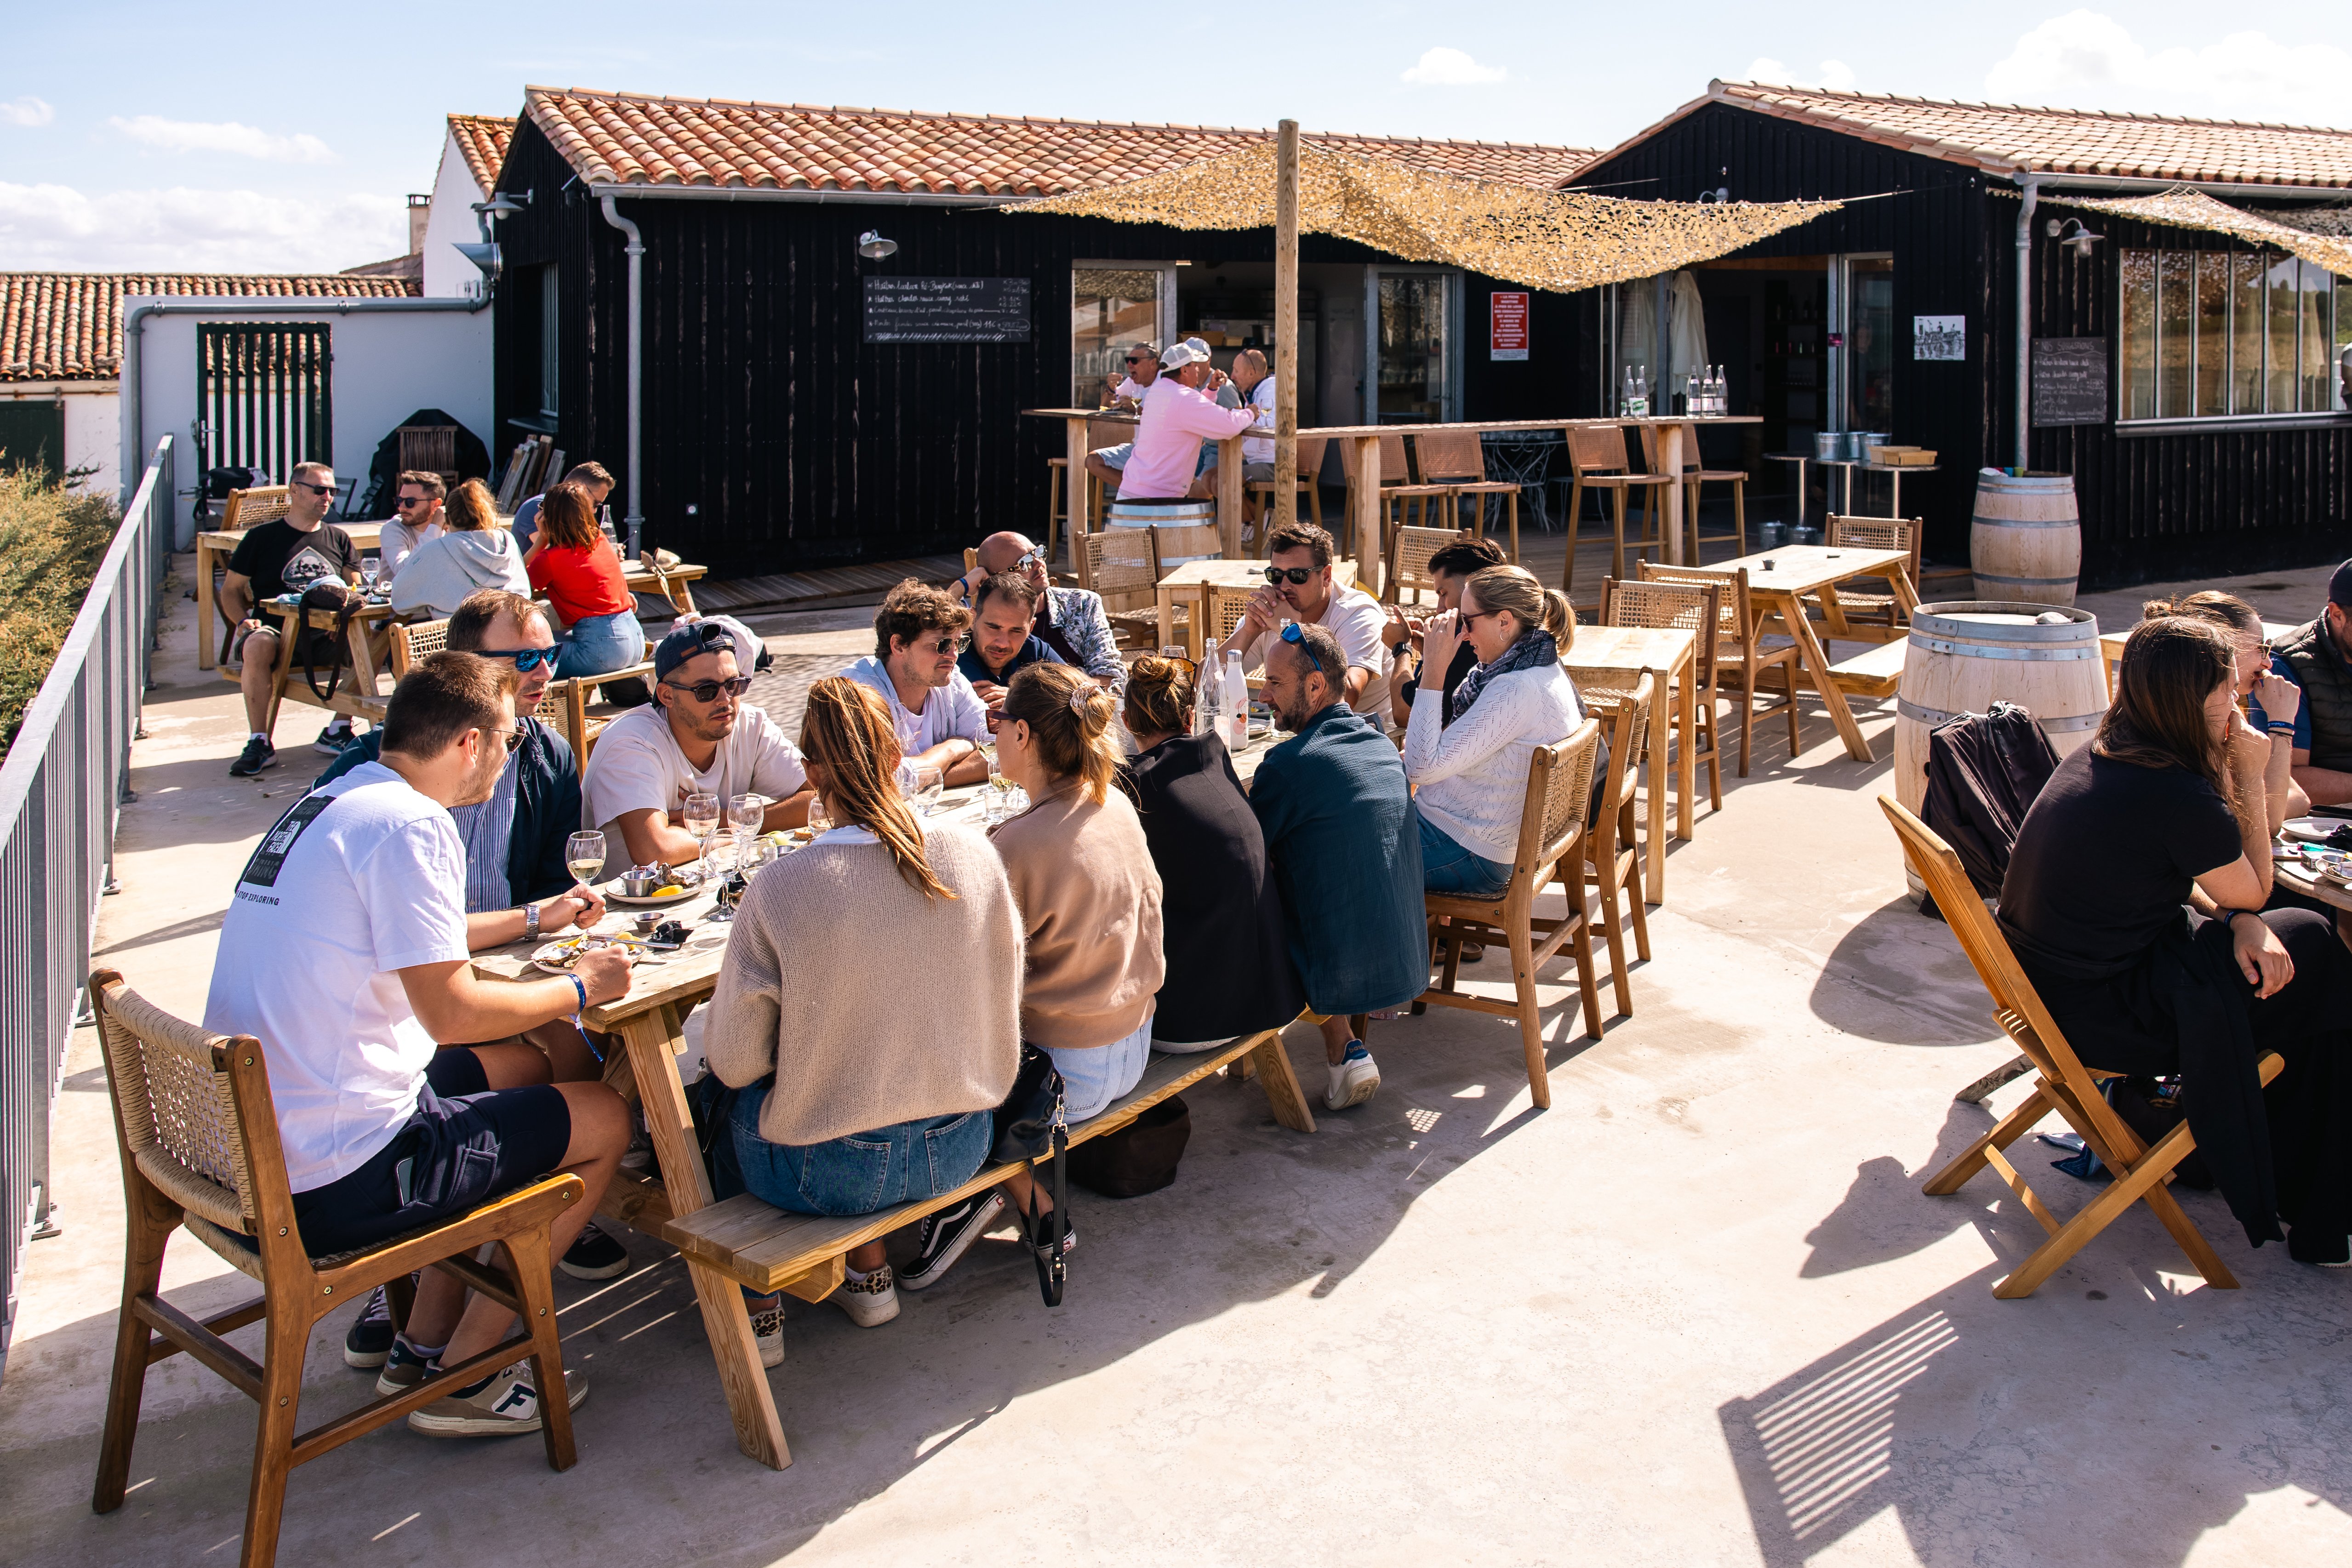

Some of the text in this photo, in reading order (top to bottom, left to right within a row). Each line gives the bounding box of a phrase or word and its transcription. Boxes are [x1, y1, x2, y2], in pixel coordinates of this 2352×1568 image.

[237, 890, 249, 900] STOP
[248, 893, 280, 906] EXPLORING
[495, 1383, 537, 1413] F
